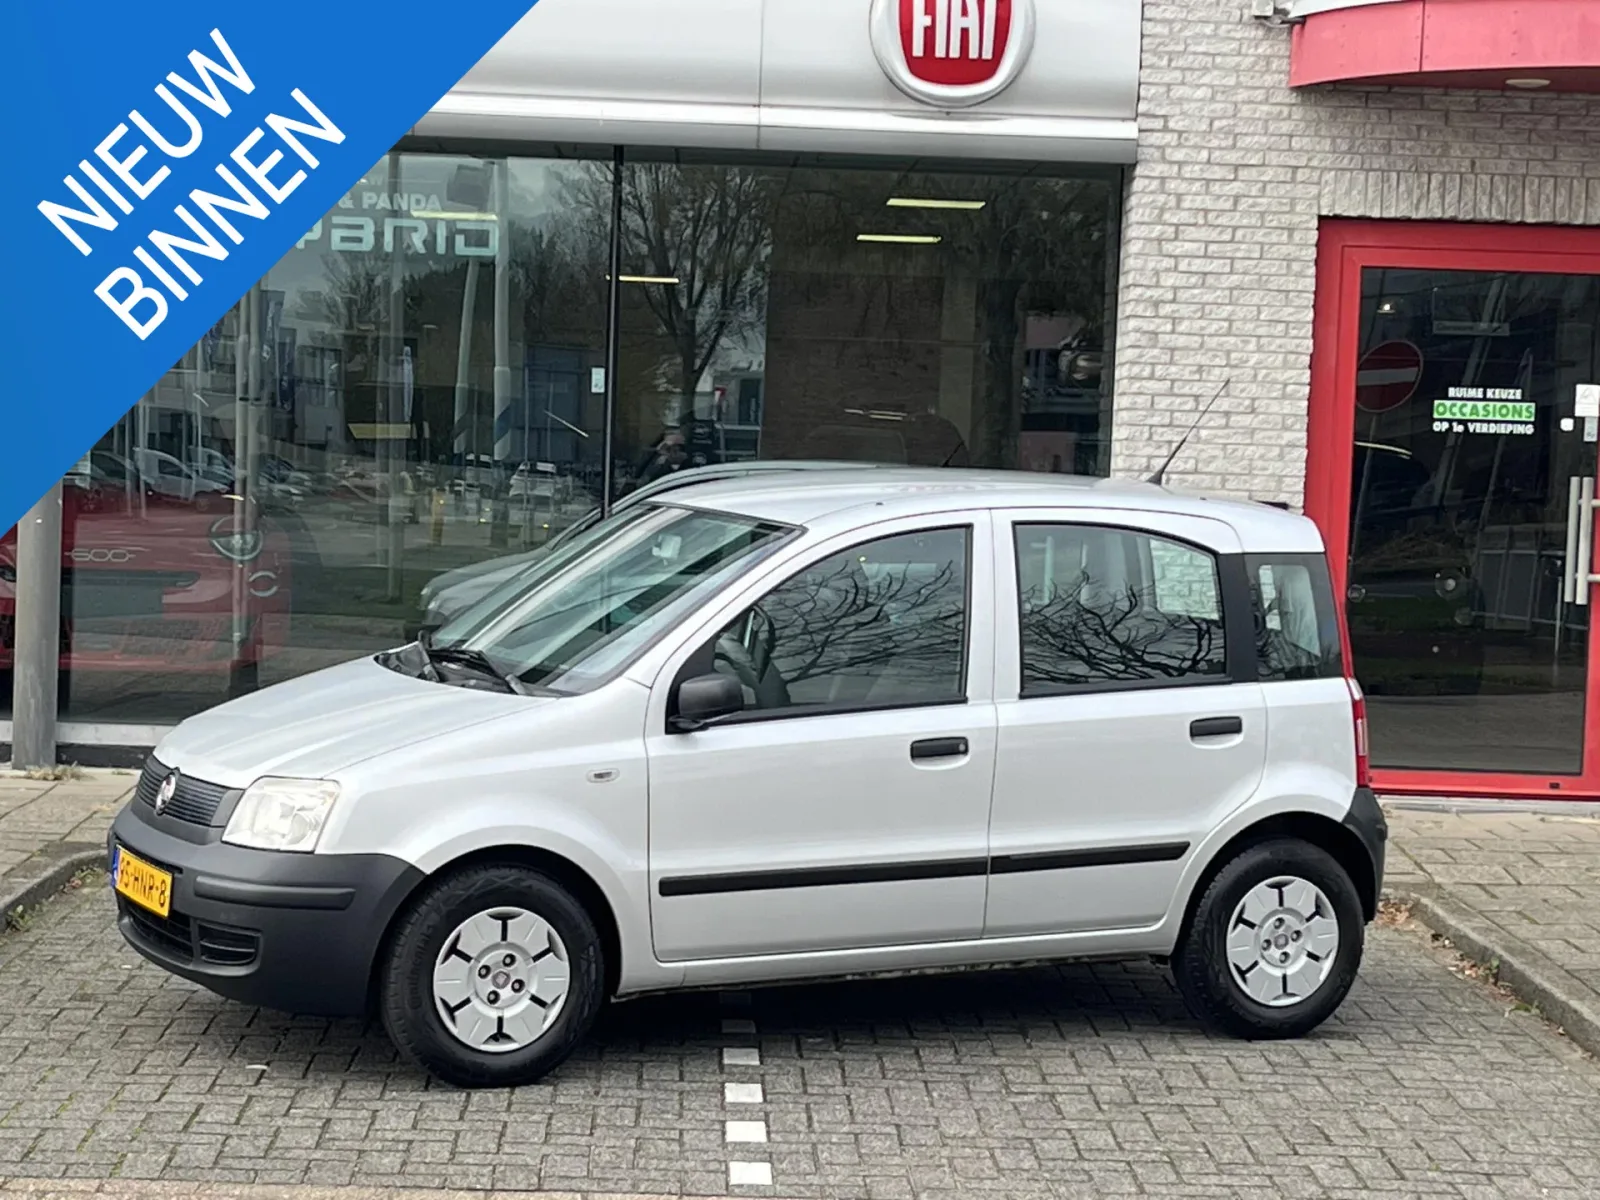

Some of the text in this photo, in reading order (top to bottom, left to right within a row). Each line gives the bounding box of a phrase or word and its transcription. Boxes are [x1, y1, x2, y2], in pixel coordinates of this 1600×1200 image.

[912, 0, 997, 59] FIAT
[362, 191, 442, 211] PANDA
[1448, 387, 1522, 400] RUIME KEUZE
[1435, 402, 1533, 419] OCCASIONS
[1432, 421, 1449, 432] OP
[1467, 422, 1535, 435] VERDIEPING
